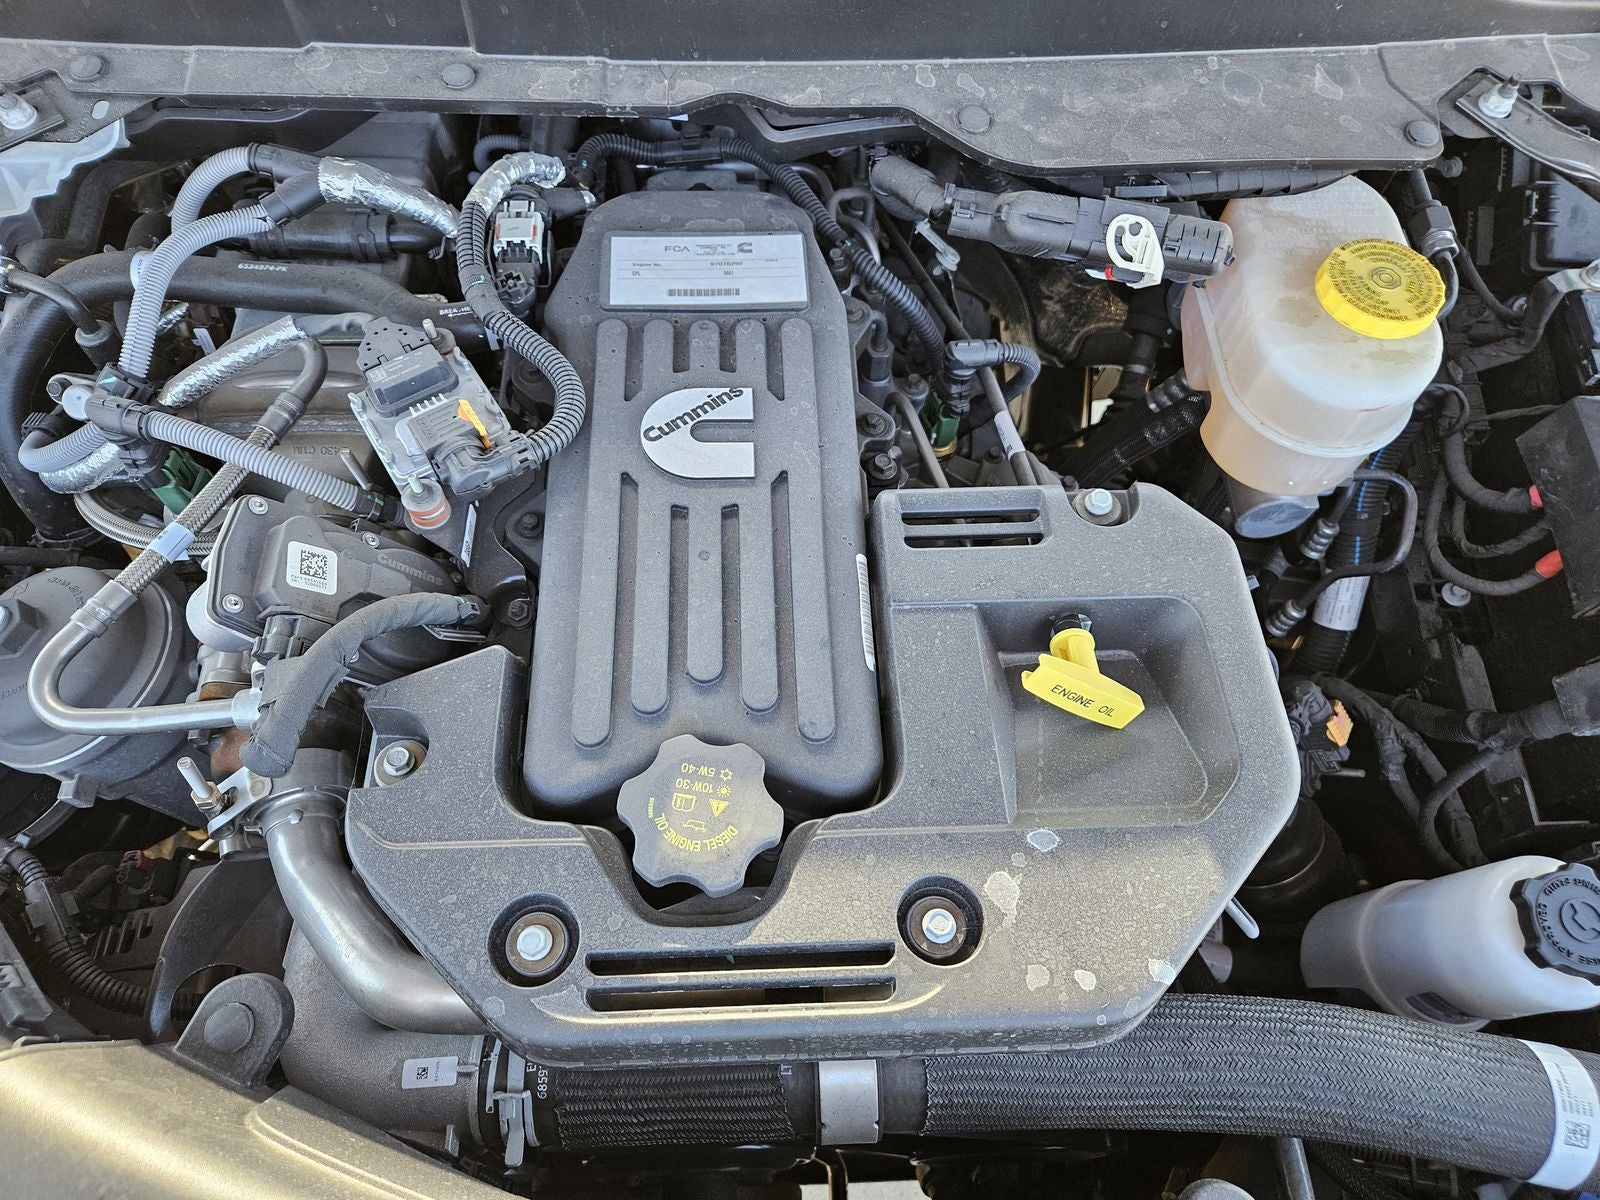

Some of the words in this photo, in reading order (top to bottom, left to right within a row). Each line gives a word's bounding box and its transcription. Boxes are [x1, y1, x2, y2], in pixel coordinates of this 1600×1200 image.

[664, 245, 690, 253] FCA
[1347, 297, 1370, 314] SEALED
[643, 386, 744, 442] Cummins
[376, 552, 444, 586] Cummins
[1051, 684, 1095, 708] ENGINE
[1098, 705, 1116, 718] OIL
[680, 762, 716, 777] 5W-40
[675, 777, 714, 794] 10W-30
[654, 812, 669, 832] OIL
[663, 826, 702, 853] ENGINE
[702, 824, 738, 852] DIESEL
[1543, 877, 1571, 897] FLUID
[1537, 902, 1575, 958] APPROVED
[537, 1065, 548, 1100] 6859
